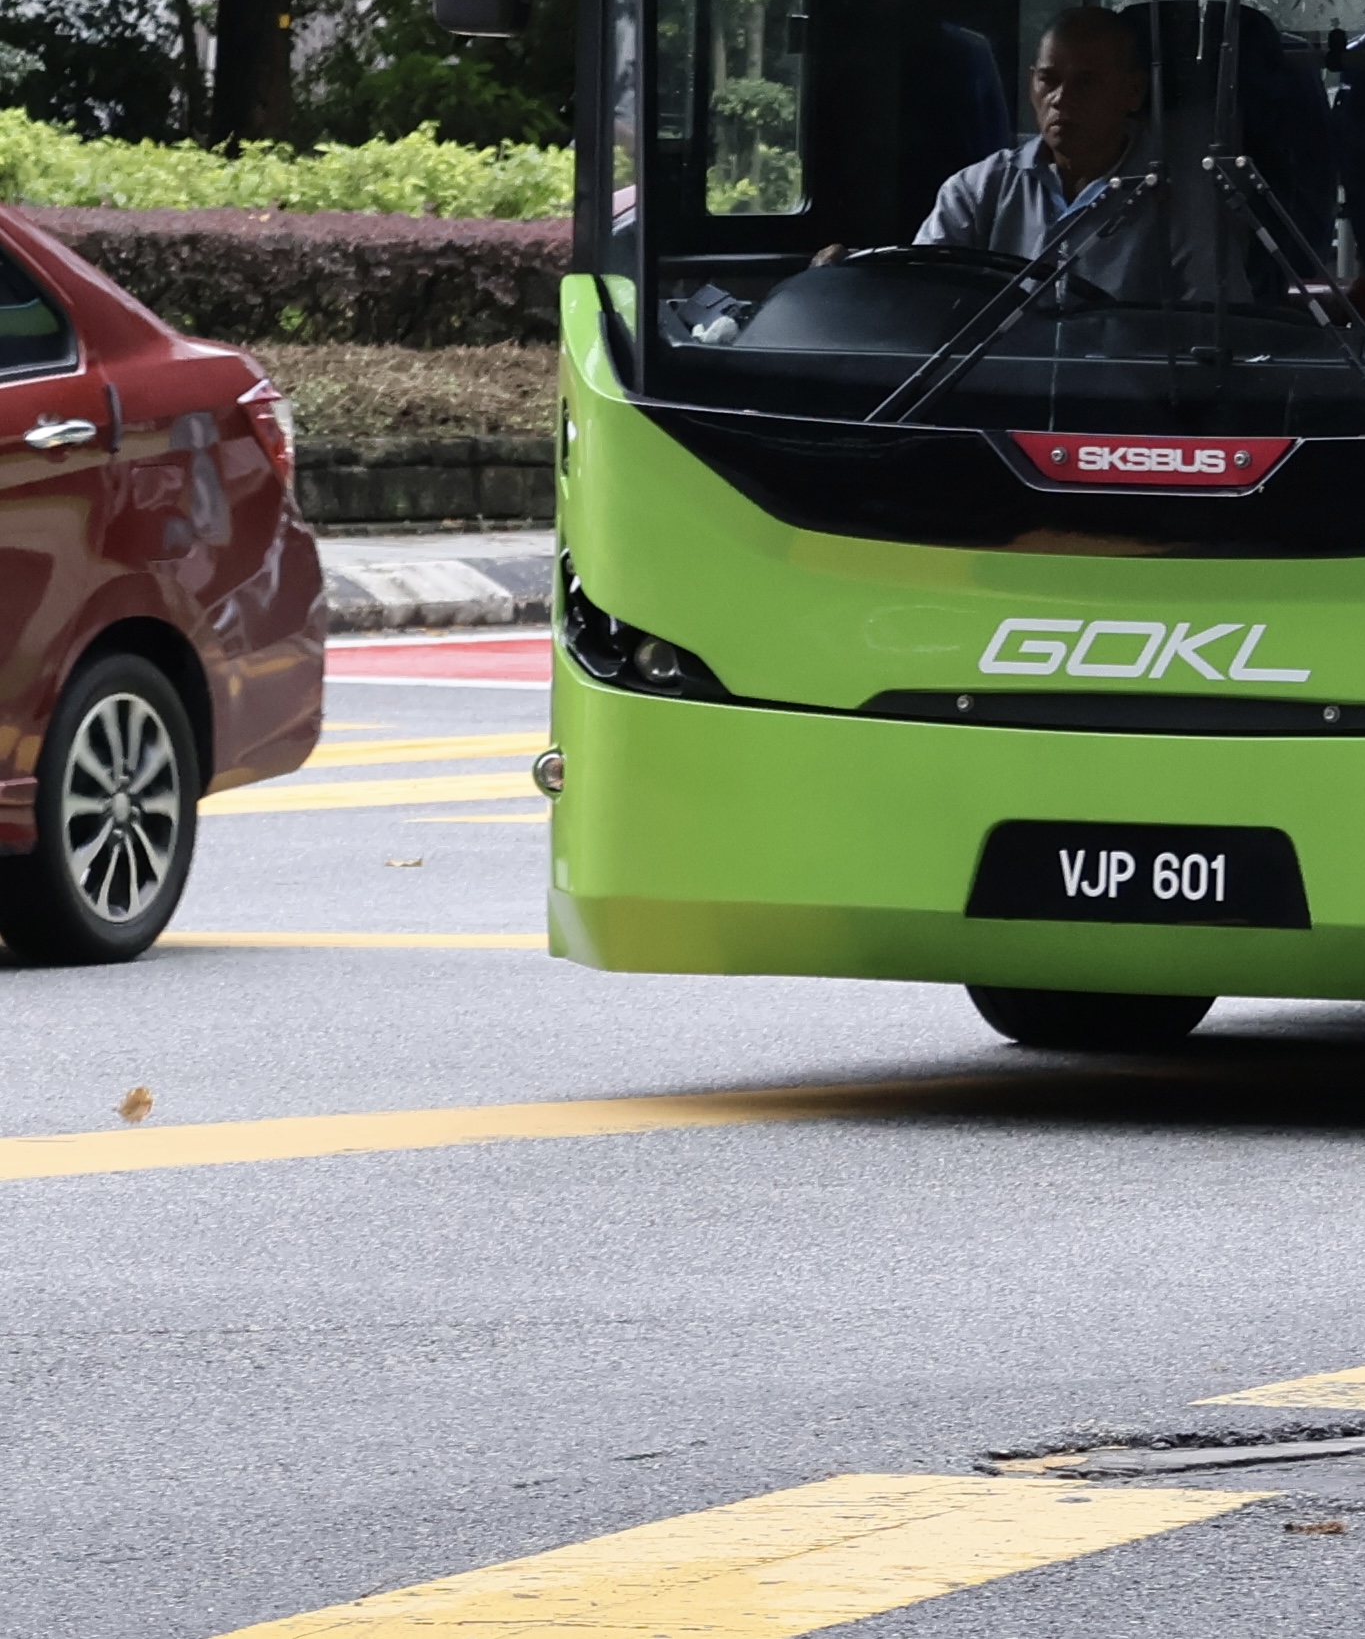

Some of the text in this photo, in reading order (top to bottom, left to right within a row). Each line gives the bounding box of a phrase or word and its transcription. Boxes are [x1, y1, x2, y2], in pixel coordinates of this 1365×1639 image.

[1077, 446, 1227, 474] SKSBUS
[978, 617, 1312, 683] GOKL
[1058, 849, 1226, 902] VJP 601
